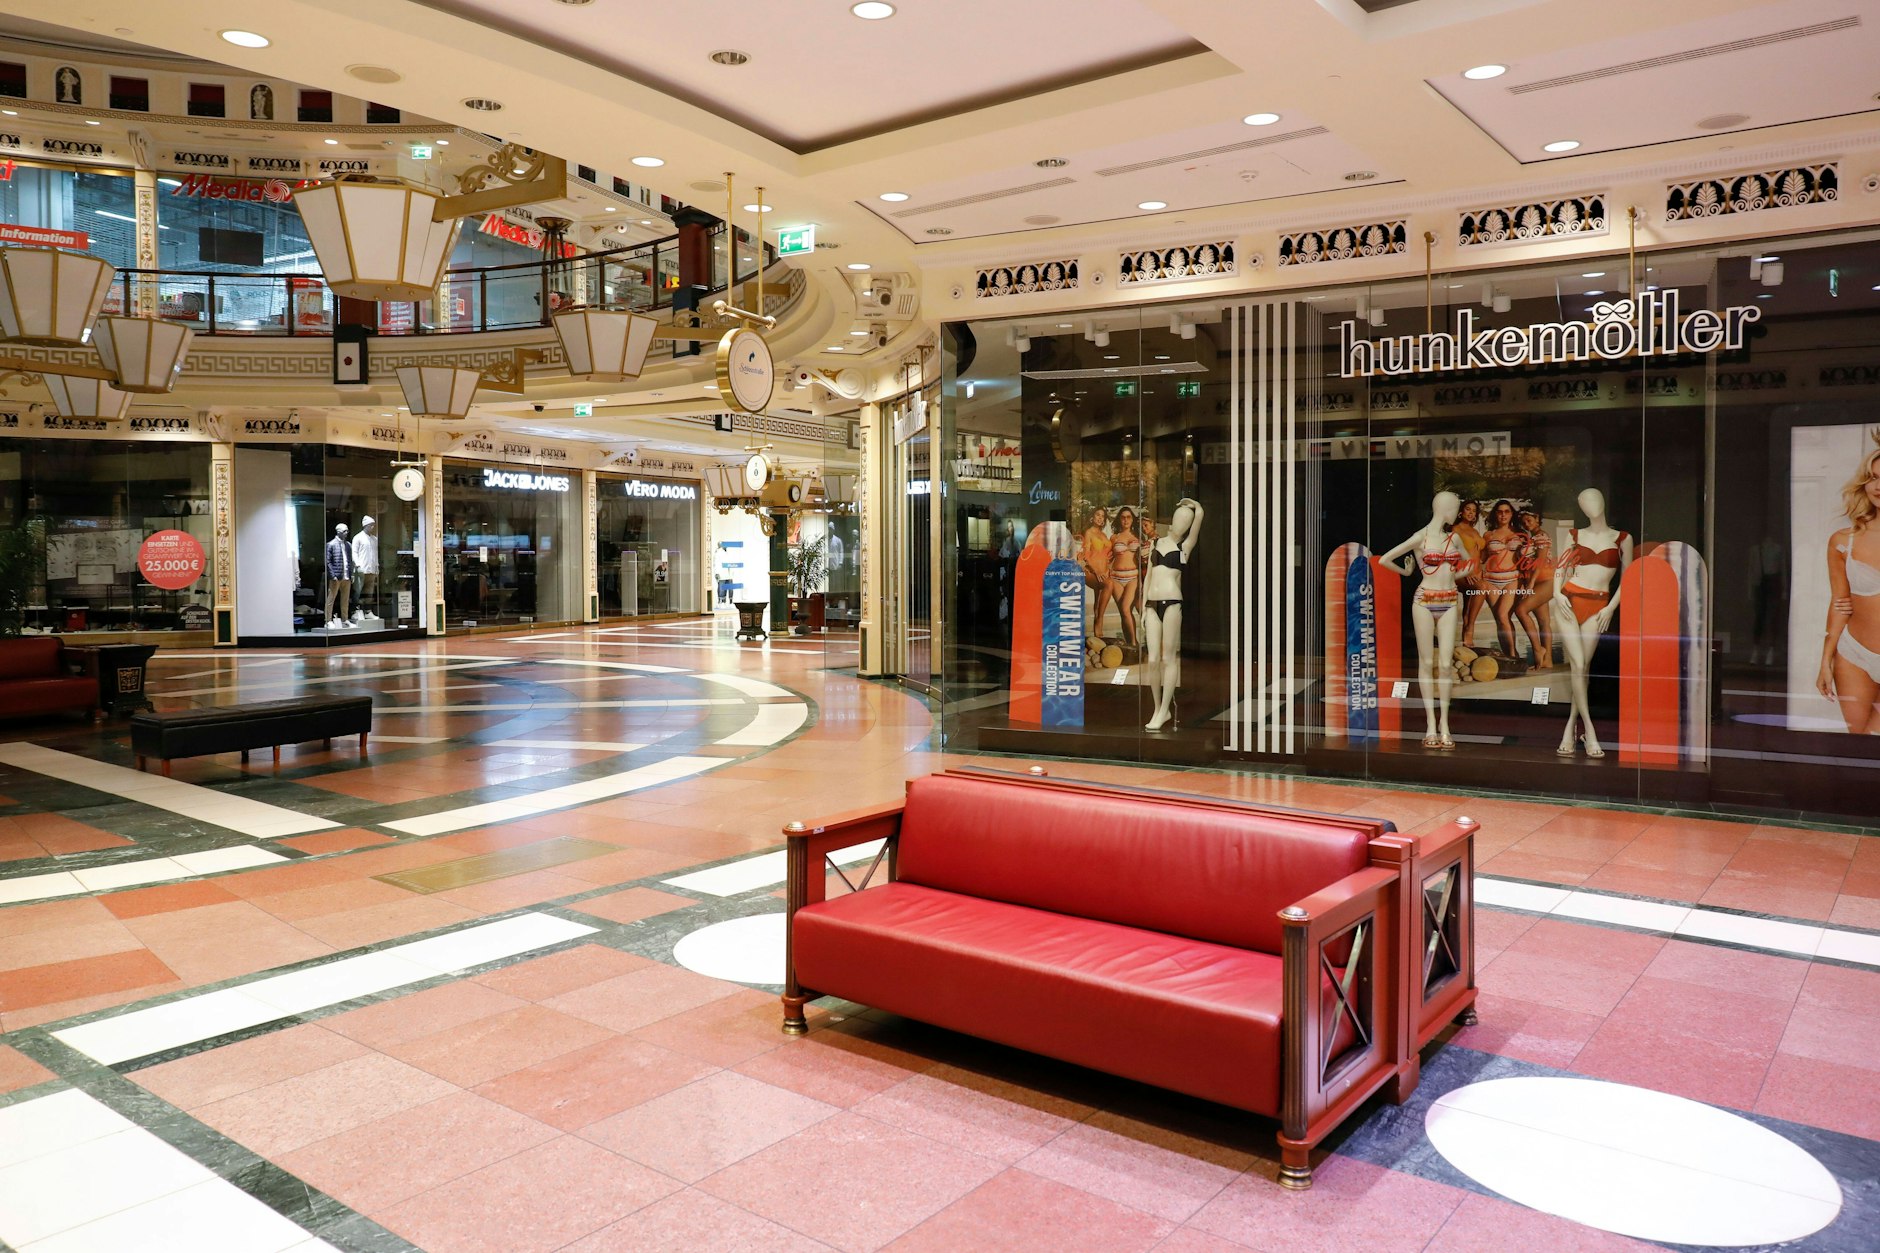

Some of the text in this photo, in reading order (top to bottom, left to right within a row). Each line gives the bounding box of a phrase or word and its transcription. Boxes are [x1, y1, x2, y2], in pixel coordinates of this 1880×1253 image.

[171, 173, 265, 202] Media
[0, 227, 75, 245] Information
[625, 480, 695, 500] VERO MODA
[145, 559, 199, 572] 25.000 €
[1509, 588, 1536, 596] MODEL
[1058, 581, 1082, 697] SWIMWEAR
[1359, 583, 1377, 711] SWIMWEAR
[1045, 644, 1058, 696] COLLECTION
[1350, 653, 1362, 711] COLLECTION
